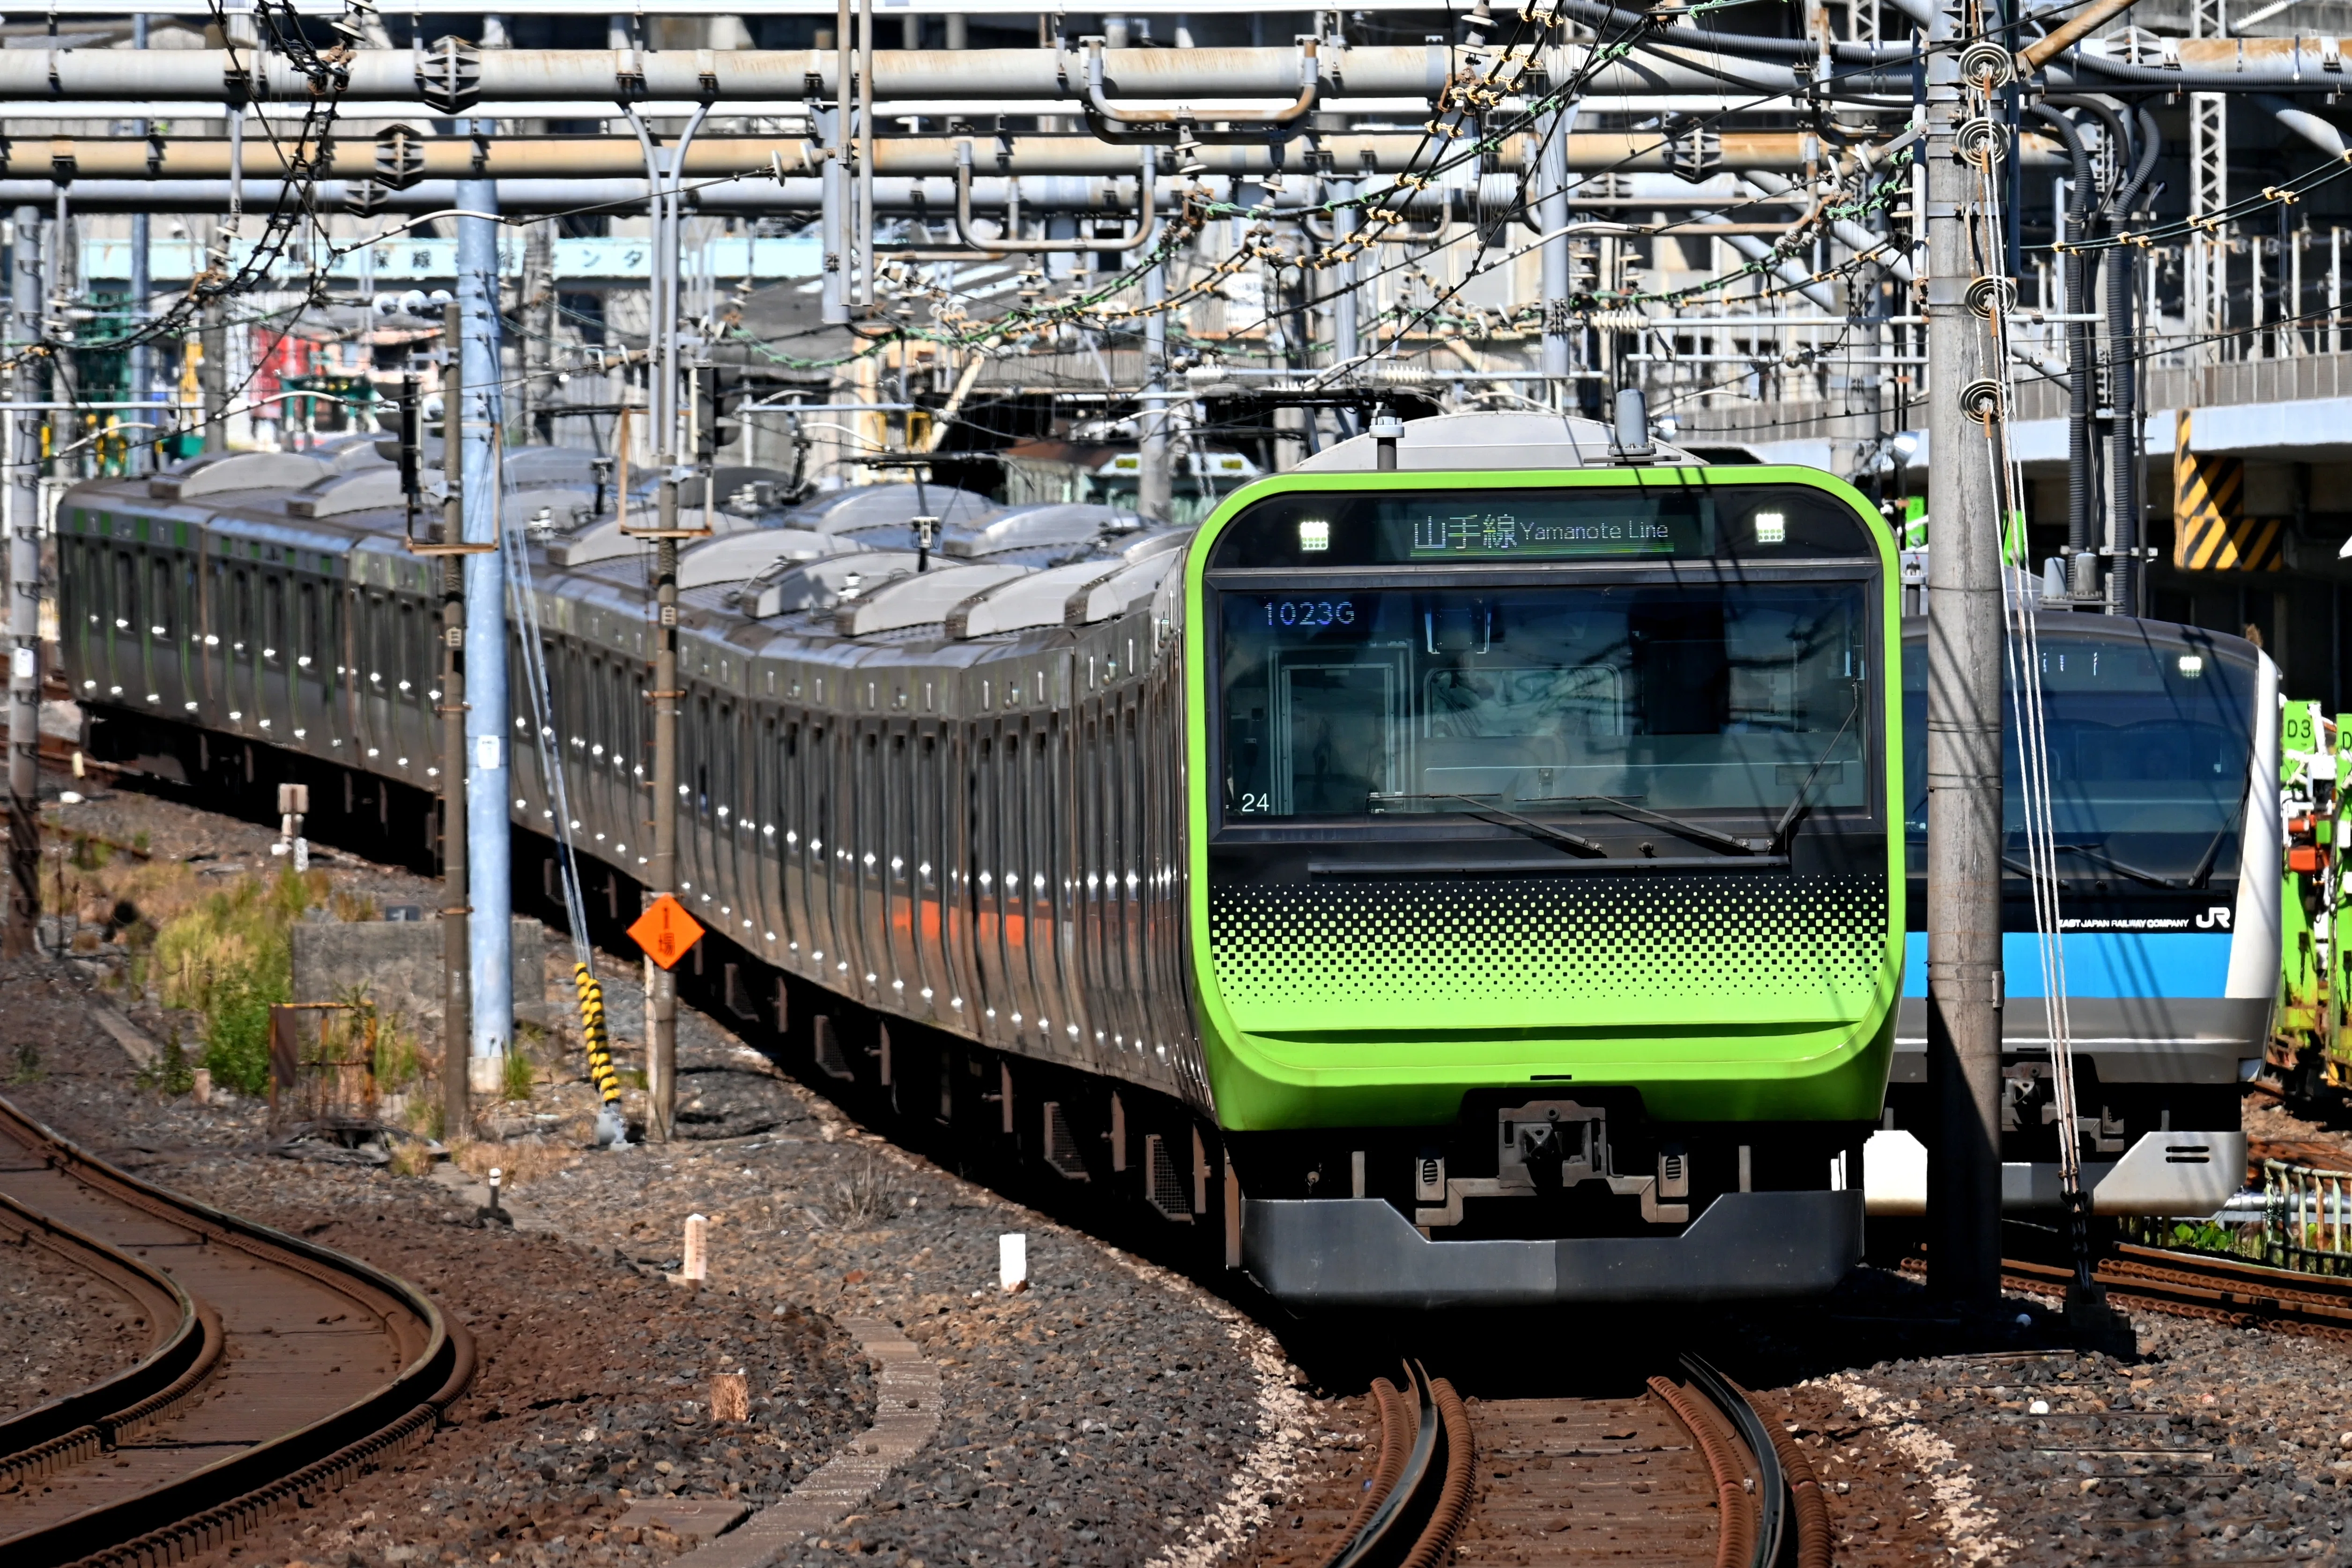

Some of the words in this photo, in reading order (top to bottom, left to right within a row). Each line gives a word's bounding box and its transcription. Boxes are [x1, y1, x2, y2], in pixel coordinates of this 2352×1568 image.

[1414, 514, 1518, 549] 山手線
[1520, 521, 1622, 540] Yamanote
[1629, 520, 1668, 538] Line
[1264, 602, 1355, 625] 1023G
[1242, 793, 1269, 812] 24
[2081, 919, 2110, 928] JAPAN
[2111, 919, 2146, 928] RAILWAY
[2147, 919, 2189, 928] COMPANY
[2196, 907, 2231, 929] JR
